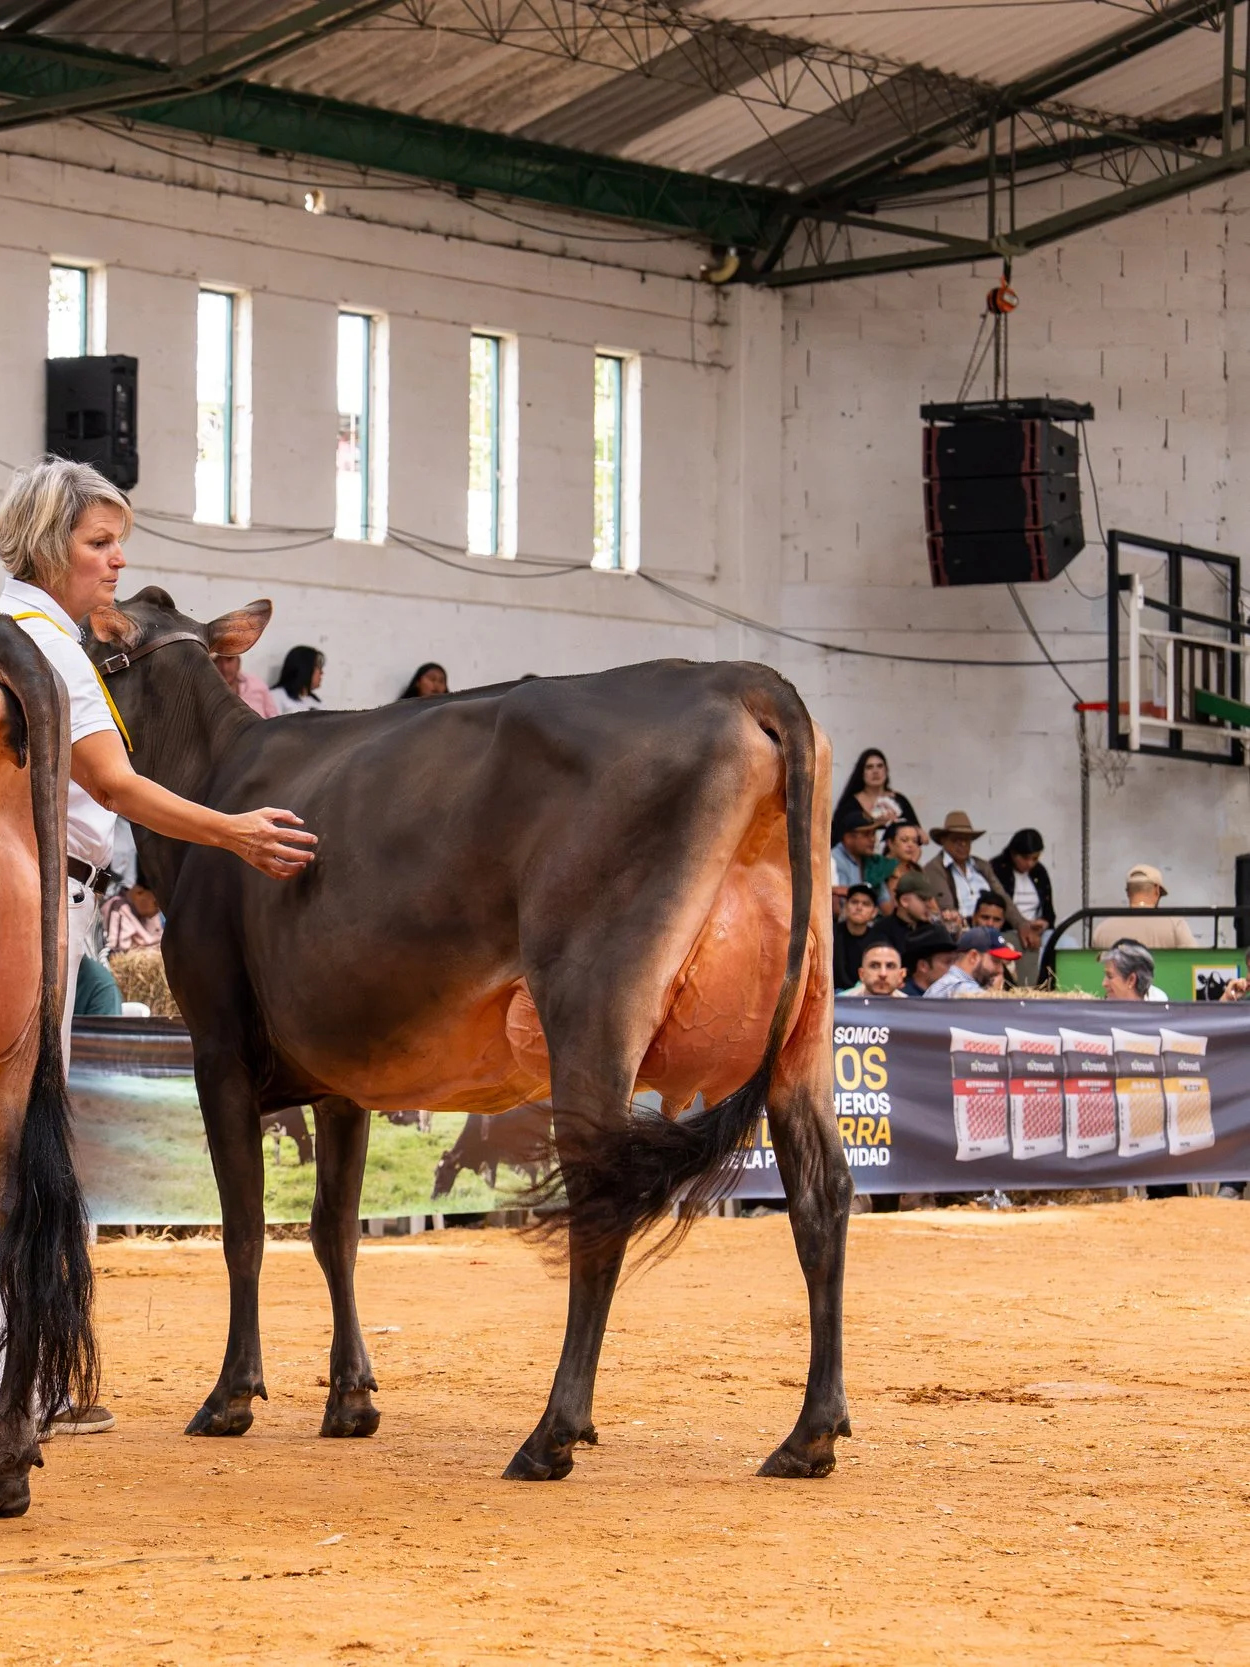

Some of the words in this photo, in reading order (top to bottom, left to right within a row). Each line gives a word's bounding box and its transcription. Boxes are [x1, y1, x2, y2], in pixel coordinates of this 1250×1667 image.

[834, 1027, 889, 1044] SOMOS
[835, 1046, 888, 1091] OS
[838, 1116, 892, 1146] RRA
[843, 1147, 890, 1167] VIDAD
